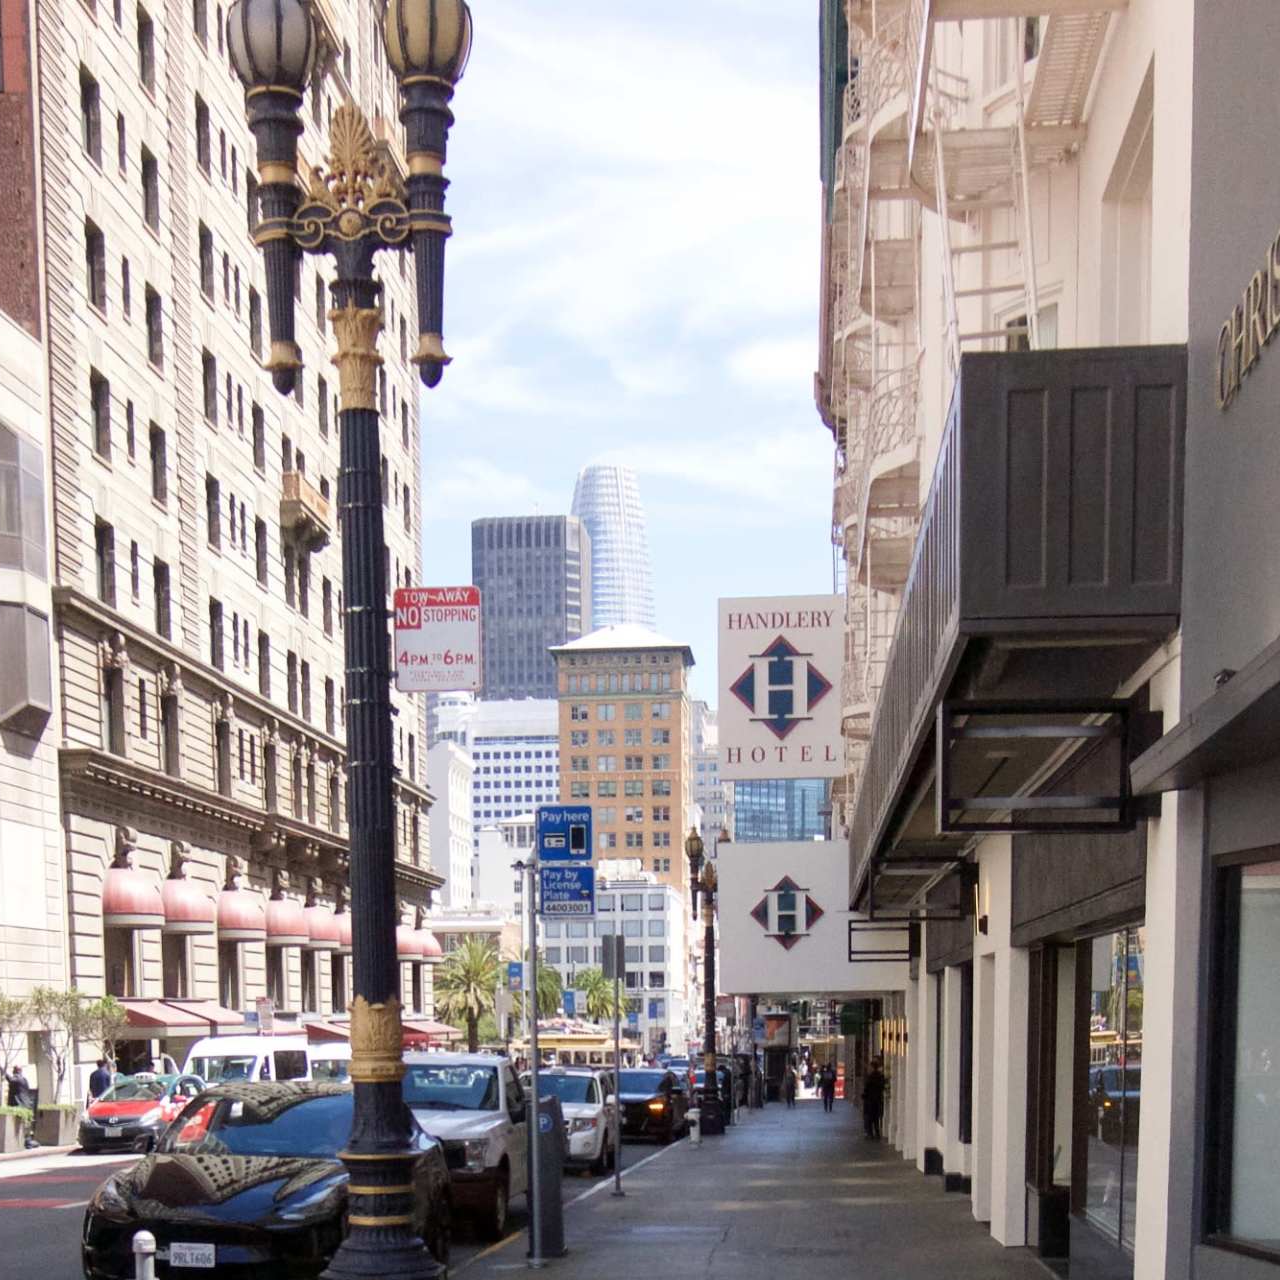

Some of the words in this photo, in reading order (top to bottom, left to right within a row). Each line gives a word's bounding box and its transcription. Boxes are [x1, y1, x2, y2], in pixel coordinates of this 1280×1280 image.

[403, 591, 469, 604] TOW-AWAY
[396, 607, 420, 626] NO
[423, 607, 477, 623] STOPPING
[728, 610, 834, 630] HANDLERY
[727, 745, 837, 764] HOTEL
[541, 811, 562, 824] Pay
[564, 811, 590, 821] here
[543, 870, 562, 881] Pay
[565, 870, 578, 881] by
[543, 881, 582, 890] License
[543, 892, 570, 900] Plate
